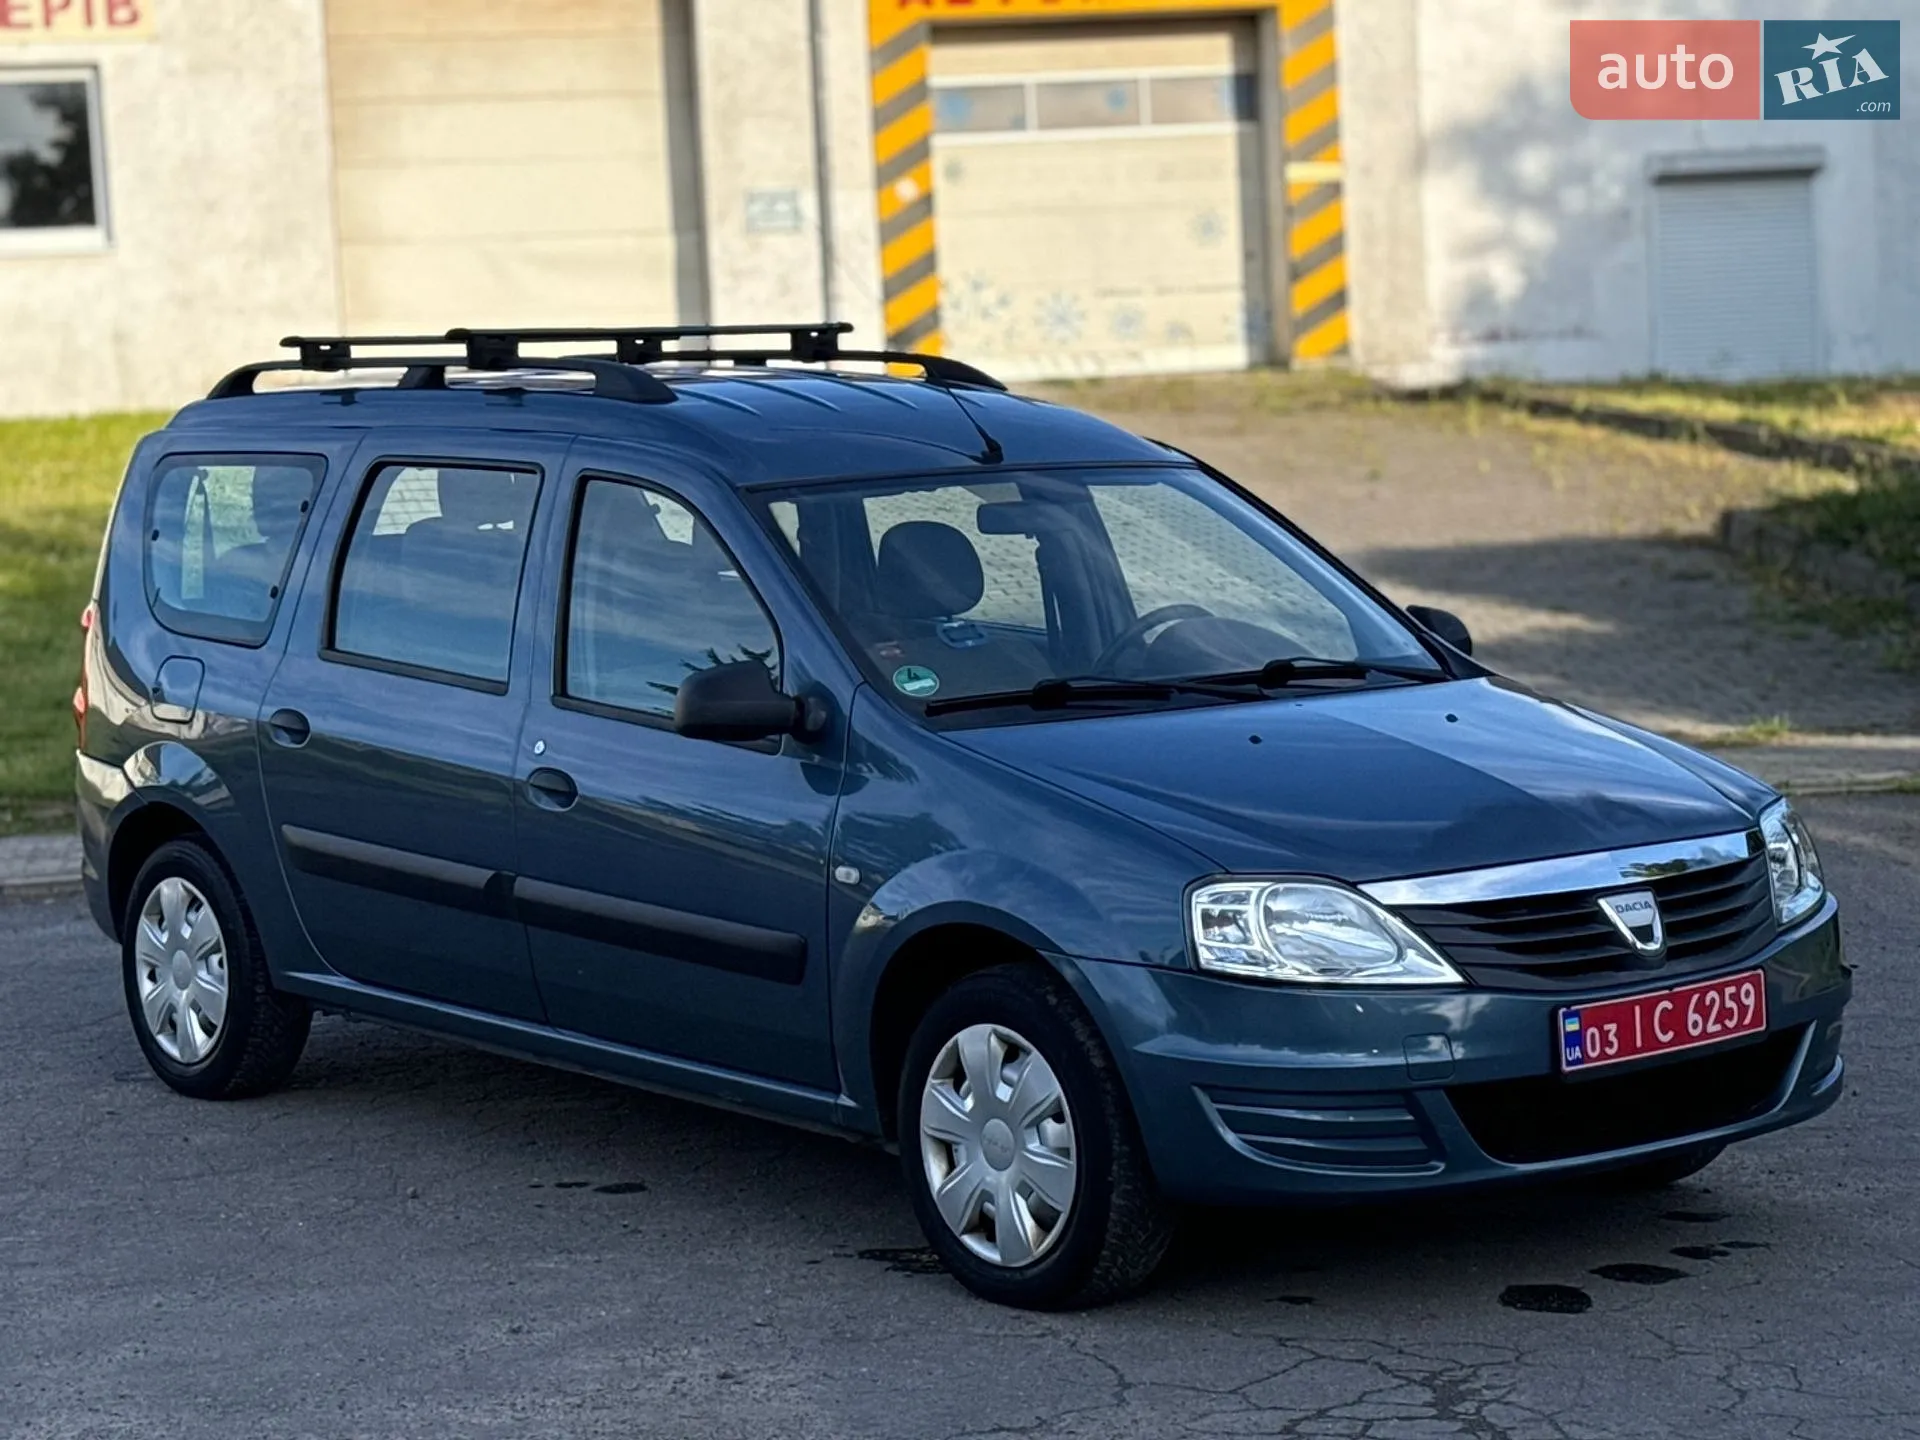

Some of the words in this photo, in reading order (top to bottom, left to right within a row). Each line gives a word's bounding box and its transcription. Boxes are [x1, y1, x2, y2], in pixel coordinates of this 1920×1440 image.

[1615, 900, 1652, 913] DACIA
[1586, 1022, 1619, 1058] 03
[1687, 982, 1755, 1037] 6259
[1566, 1045, 1582, 1061] UA
